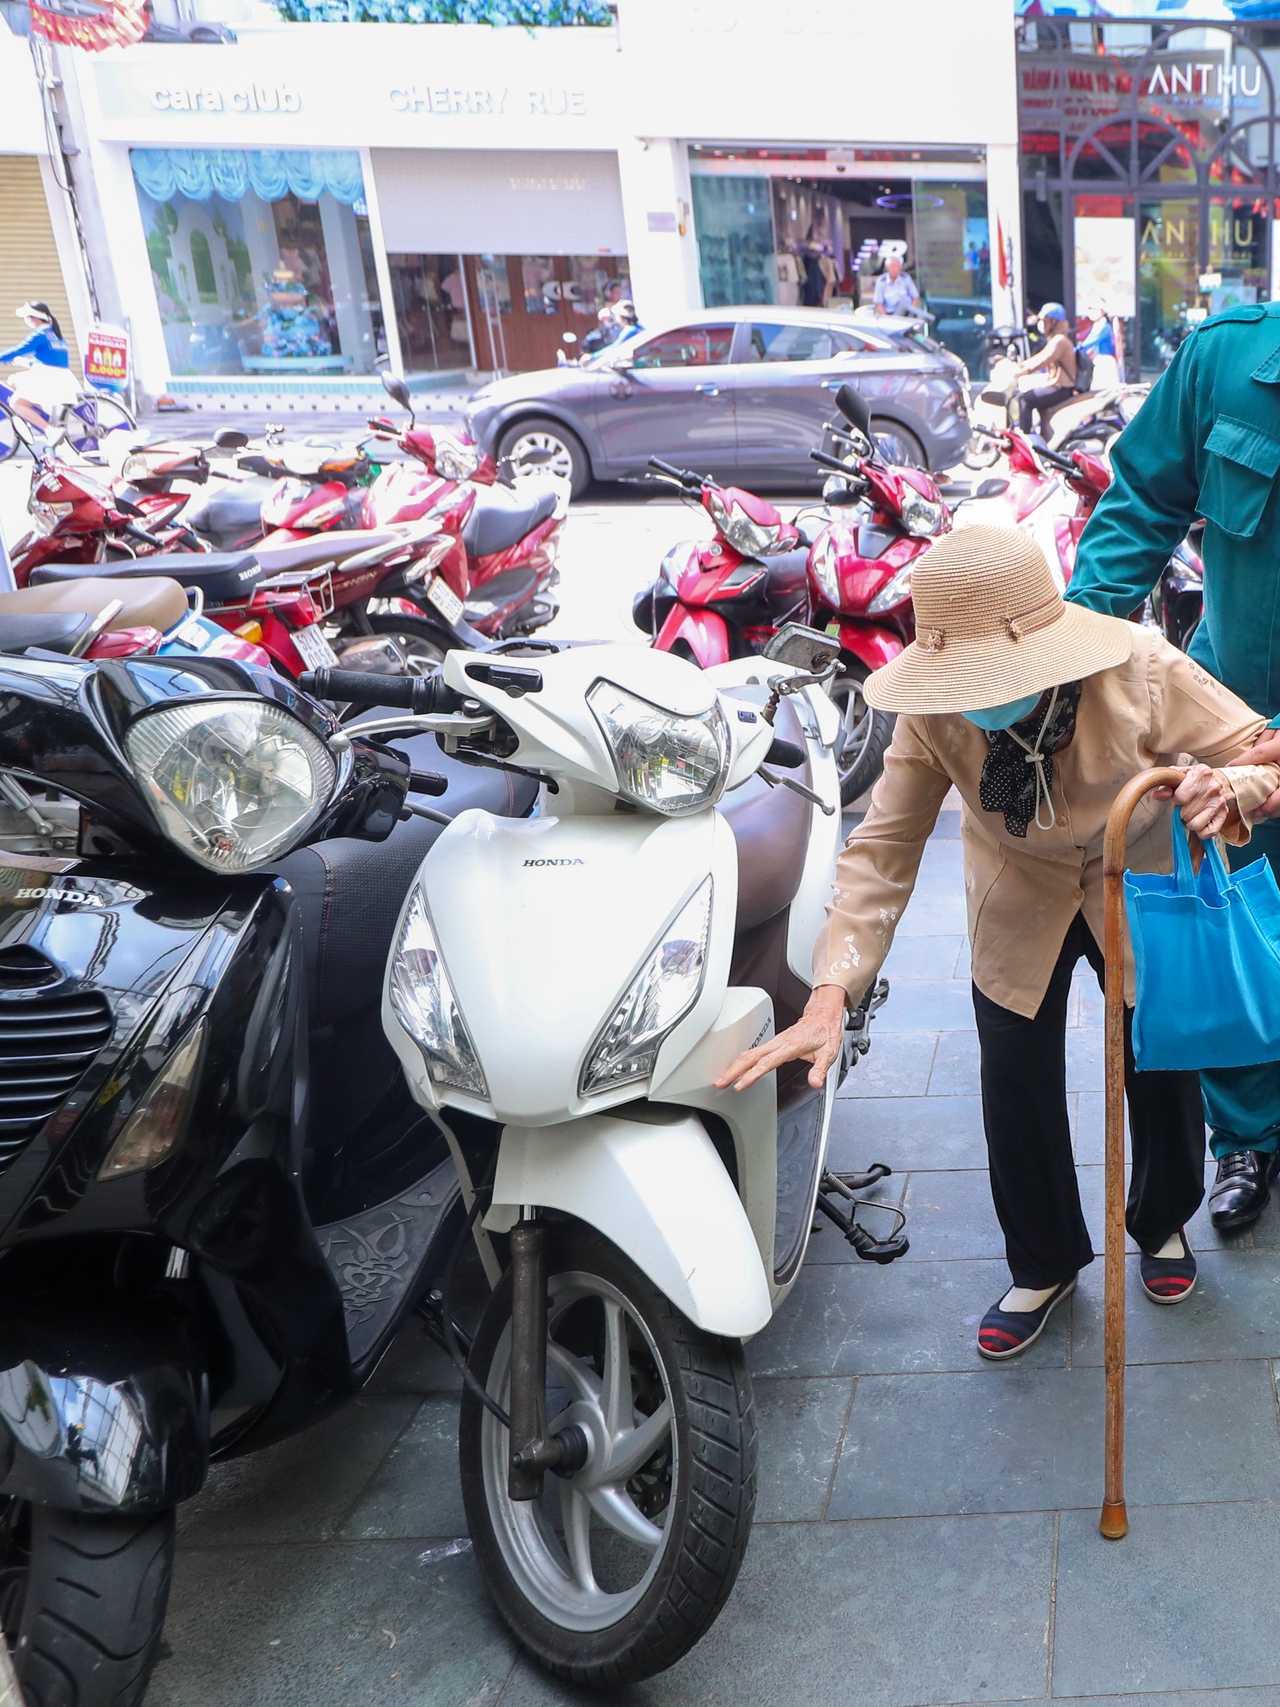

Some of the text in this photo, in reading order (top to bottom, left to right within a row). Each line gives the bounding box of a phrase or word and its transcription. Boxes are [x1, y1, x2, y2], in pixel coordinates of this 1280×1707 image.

[150, 82, 302, 113] cara club
[389, 87, 587, 116] CHERRY RUE
[522, 858, 585, 867] HONDA
[14, 888, 106, 908] HONDA
